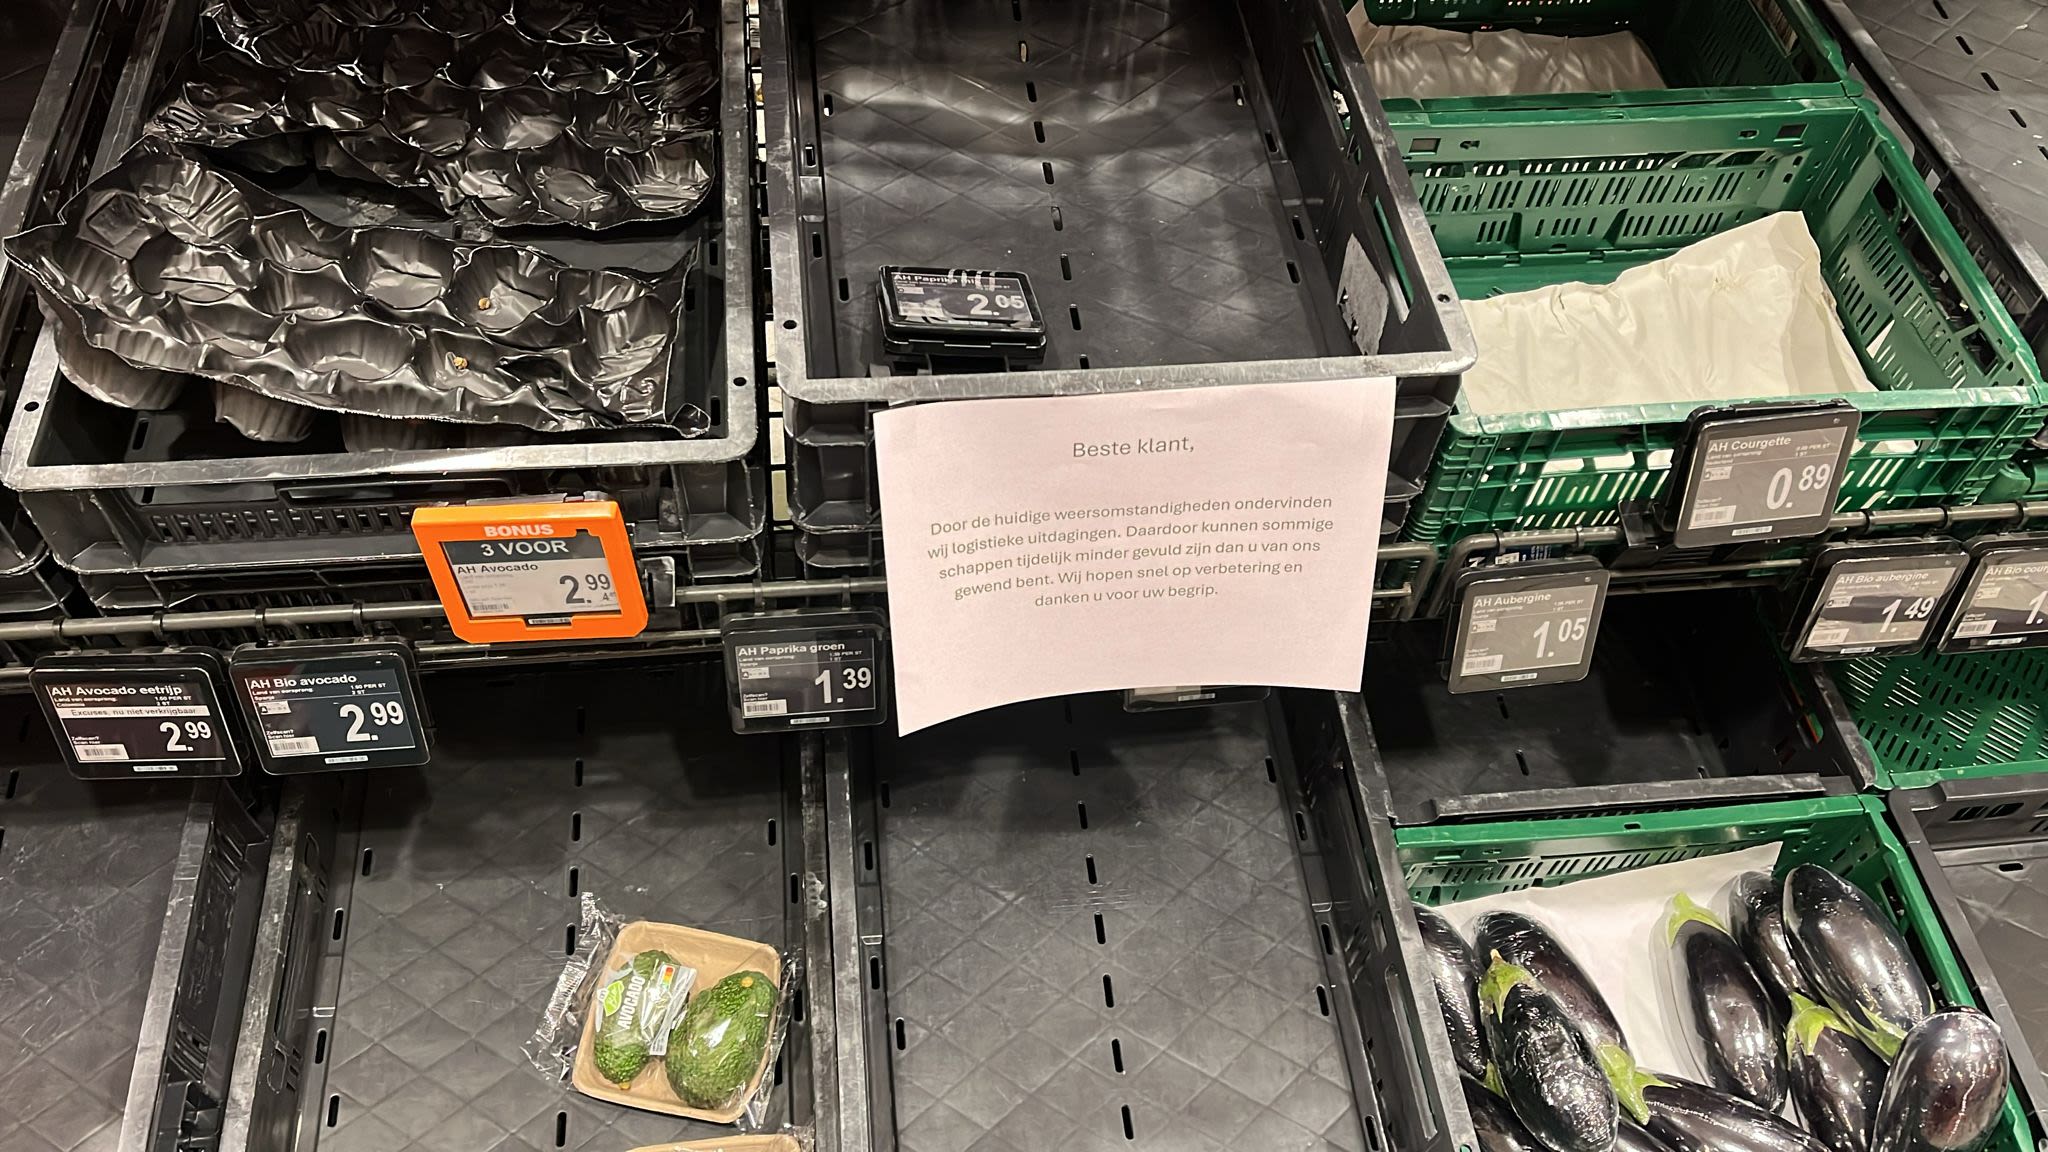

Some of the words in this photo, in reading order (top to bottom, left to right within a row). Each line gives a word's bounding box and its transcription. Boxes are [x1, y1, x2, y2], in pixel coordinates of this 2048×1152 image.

[967, 294, 1025, 316] 2.05
[1072, 440, 1131, 457] Beste
[1137, 436, 1195, 454] klant,
[1708, 442, 1728, 453] AH
[1731, 436, 1792, 450] Courgette
[1766, 464, 1831, 510] 0.89
[930, 519, 968, 536] Door
[971, 515, 991, 529] de
[994, 509, 1051, 525] huidige
[1054, 499, 1231, 521] weersomstandigheden
[1234, 496, 1333, 511] ondervinden
[483, 524, 555, 538] BONUS
[927, 544, 949, 560] wij
[951, 533, 1024, 556] logistieke
[1027, 527, 1121, 545] uitdagingen.
[1126, 523, 1198, 538] Daardoor
[1201, 520, 1258, 534] kunnen
[1262, 517, 1334, 533] sommige
[480, 543, 495, 557] 3
[498, 540, 570, 556] VOOR
[939, 558, 1013, 579] schappen
[1016, 550, 1072, 569] tijdelijk
[1075, 548, 1129, 561] minder
[1132, 543, 1182, 560] gevuld
[1185, 542, 1212, 557] zijn
[1215, 541, 1244, 554] dan
[1248, 542, 1257, 552] u
[1261, 540, 1288, 552] van
[1292, 540, 1321, 551] ons
[457, 565, 476, 575] AH
[480, 562, 539, 573] Avocado
[1837, 575, 1854, 585] AH
[1856, 574, 1874, 584] Bio
[1875, 571, 1929, 582] aubergine
[1987, 568, 2004, 576] AH
[2004, 566, 2022, 575] Bio
[559, 573, 611, 605] 2.99
[954, 578, 1012, 600] gewend
[1016, 574, 1054, 588] bent.
[1057, 570, 1082, 585] Wij
[1085, 567, 1133, 583] hopen
[1137, 564, 1168, 578] snel
[1172, 565, 1191, 578] op
[1195, 561, 1281, 576] verbetering
[1284, 562, 1302, 573] en
[1034, 592, 1089, 607] danken
[1093, 591, 1102, 601] u
[1106, 589, 1138, 601] voor
[1142, 588, 1164, 599] uw
[1168, 583, 1219, 599] begrip.
[1473, 598, 1491, 608] AH
[1494, 593, 1552, 606] Aubergine
[1880, 597, 1935, 633] 1.49
[1533, 617, 1587, 659] 1.05
[738, 647, 757, 657] AH
[760, 644, 807, 657] Paprika
[809, 643, 845, 654] groen
[52, 686, 72, 697] AH
[76, 685, 136, 696] Avocado
[139, 685, 183, 697] eetrijp
[250, 679, 271, 690] AH
[274, 677, 297, 688] Bio
[299, 674, 358, 686] avocado
[814, 667, 872, 704] 1.39
[71, 709, 110, 717] Excuses,
[144, 708, 197, 717] verkrijgbaar
[339, 701, 404, 743] 2.99
[159, 721, 212, 752] 2.99
[617, 975, 646, 1030] AVOCADO
